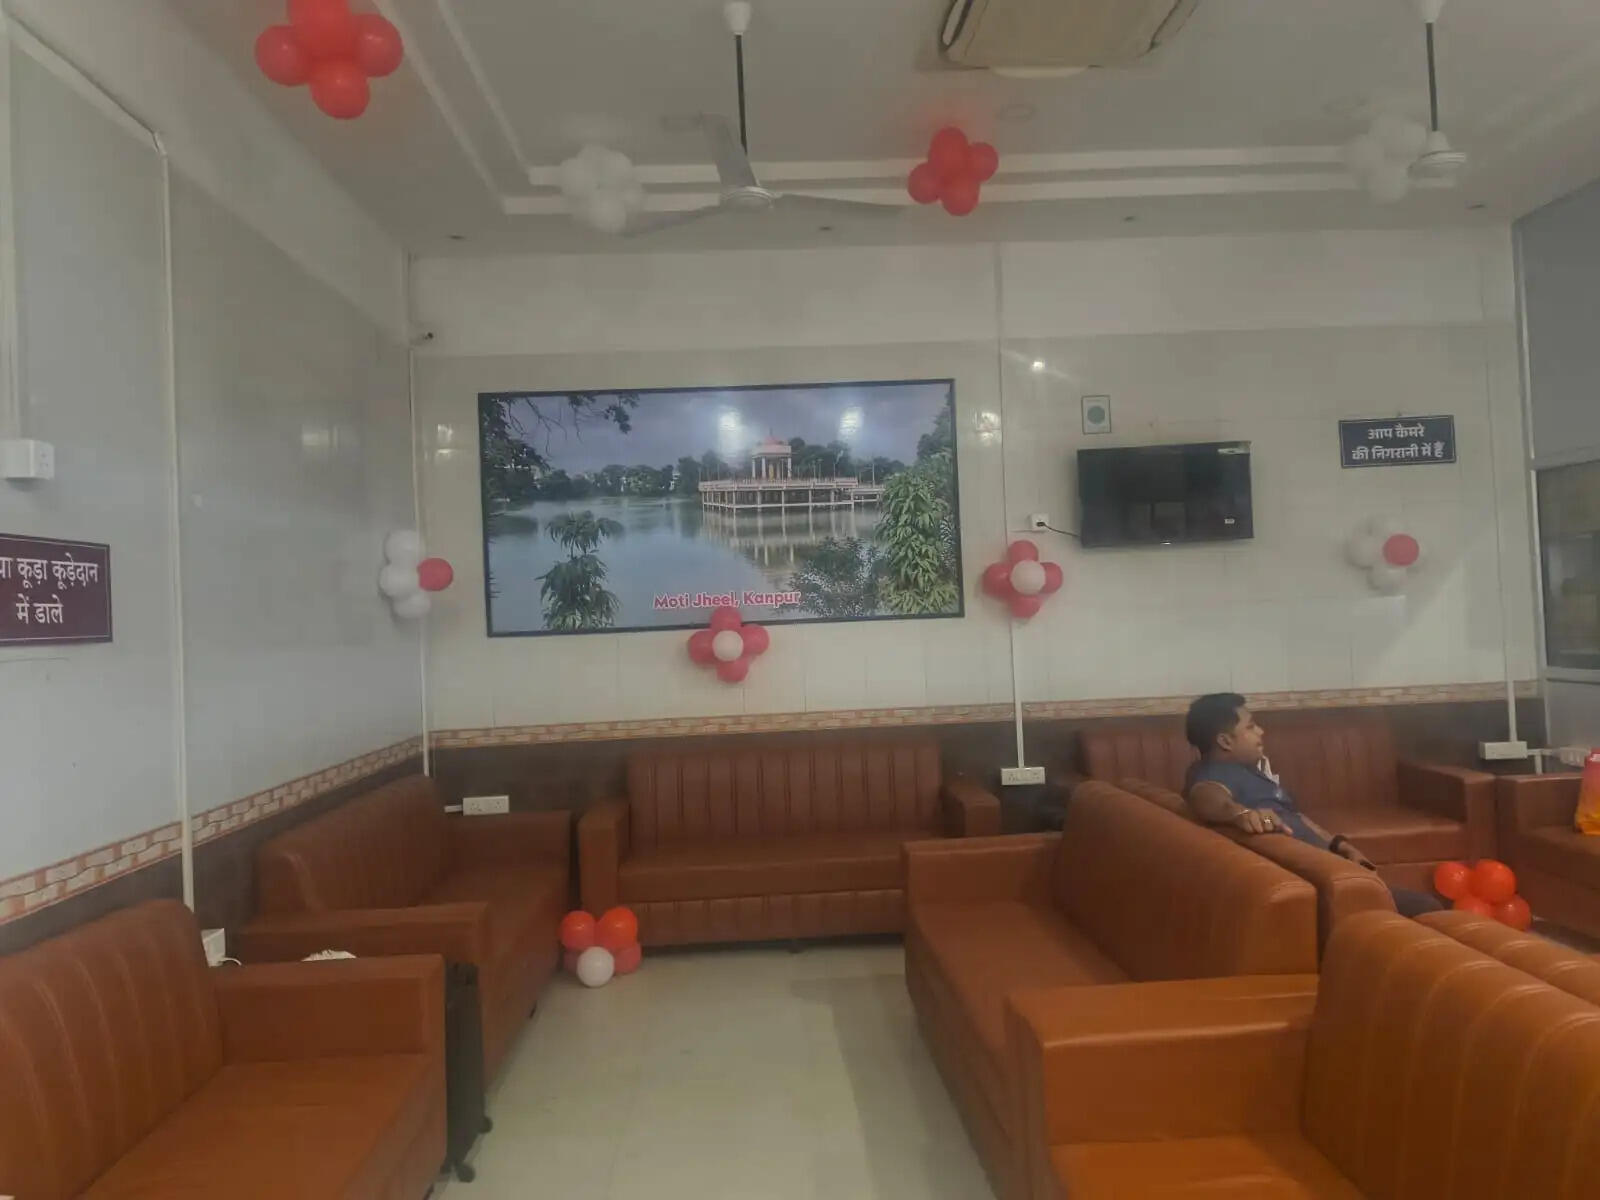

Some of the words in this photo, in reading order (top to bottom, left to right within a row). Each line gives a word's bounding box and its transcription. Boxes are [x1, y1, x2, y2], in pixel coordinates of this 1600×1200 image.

[1368, 427, 1393, 440] आप
[1394, 423, 1425, 438] कैमरे
[1352, 445, 1369, 460] की
[1421, 442, 1432, 457] में
[16, 557, 48, 589] कूड़ा
[51, 552, 98, 590] कूड़ेदान
[16, 593, 30, 624] में
[33, 594, 64, 624] डाले
[654, 591, 690, 609] Moti
[692, 590, 739, 608] Jheel,
